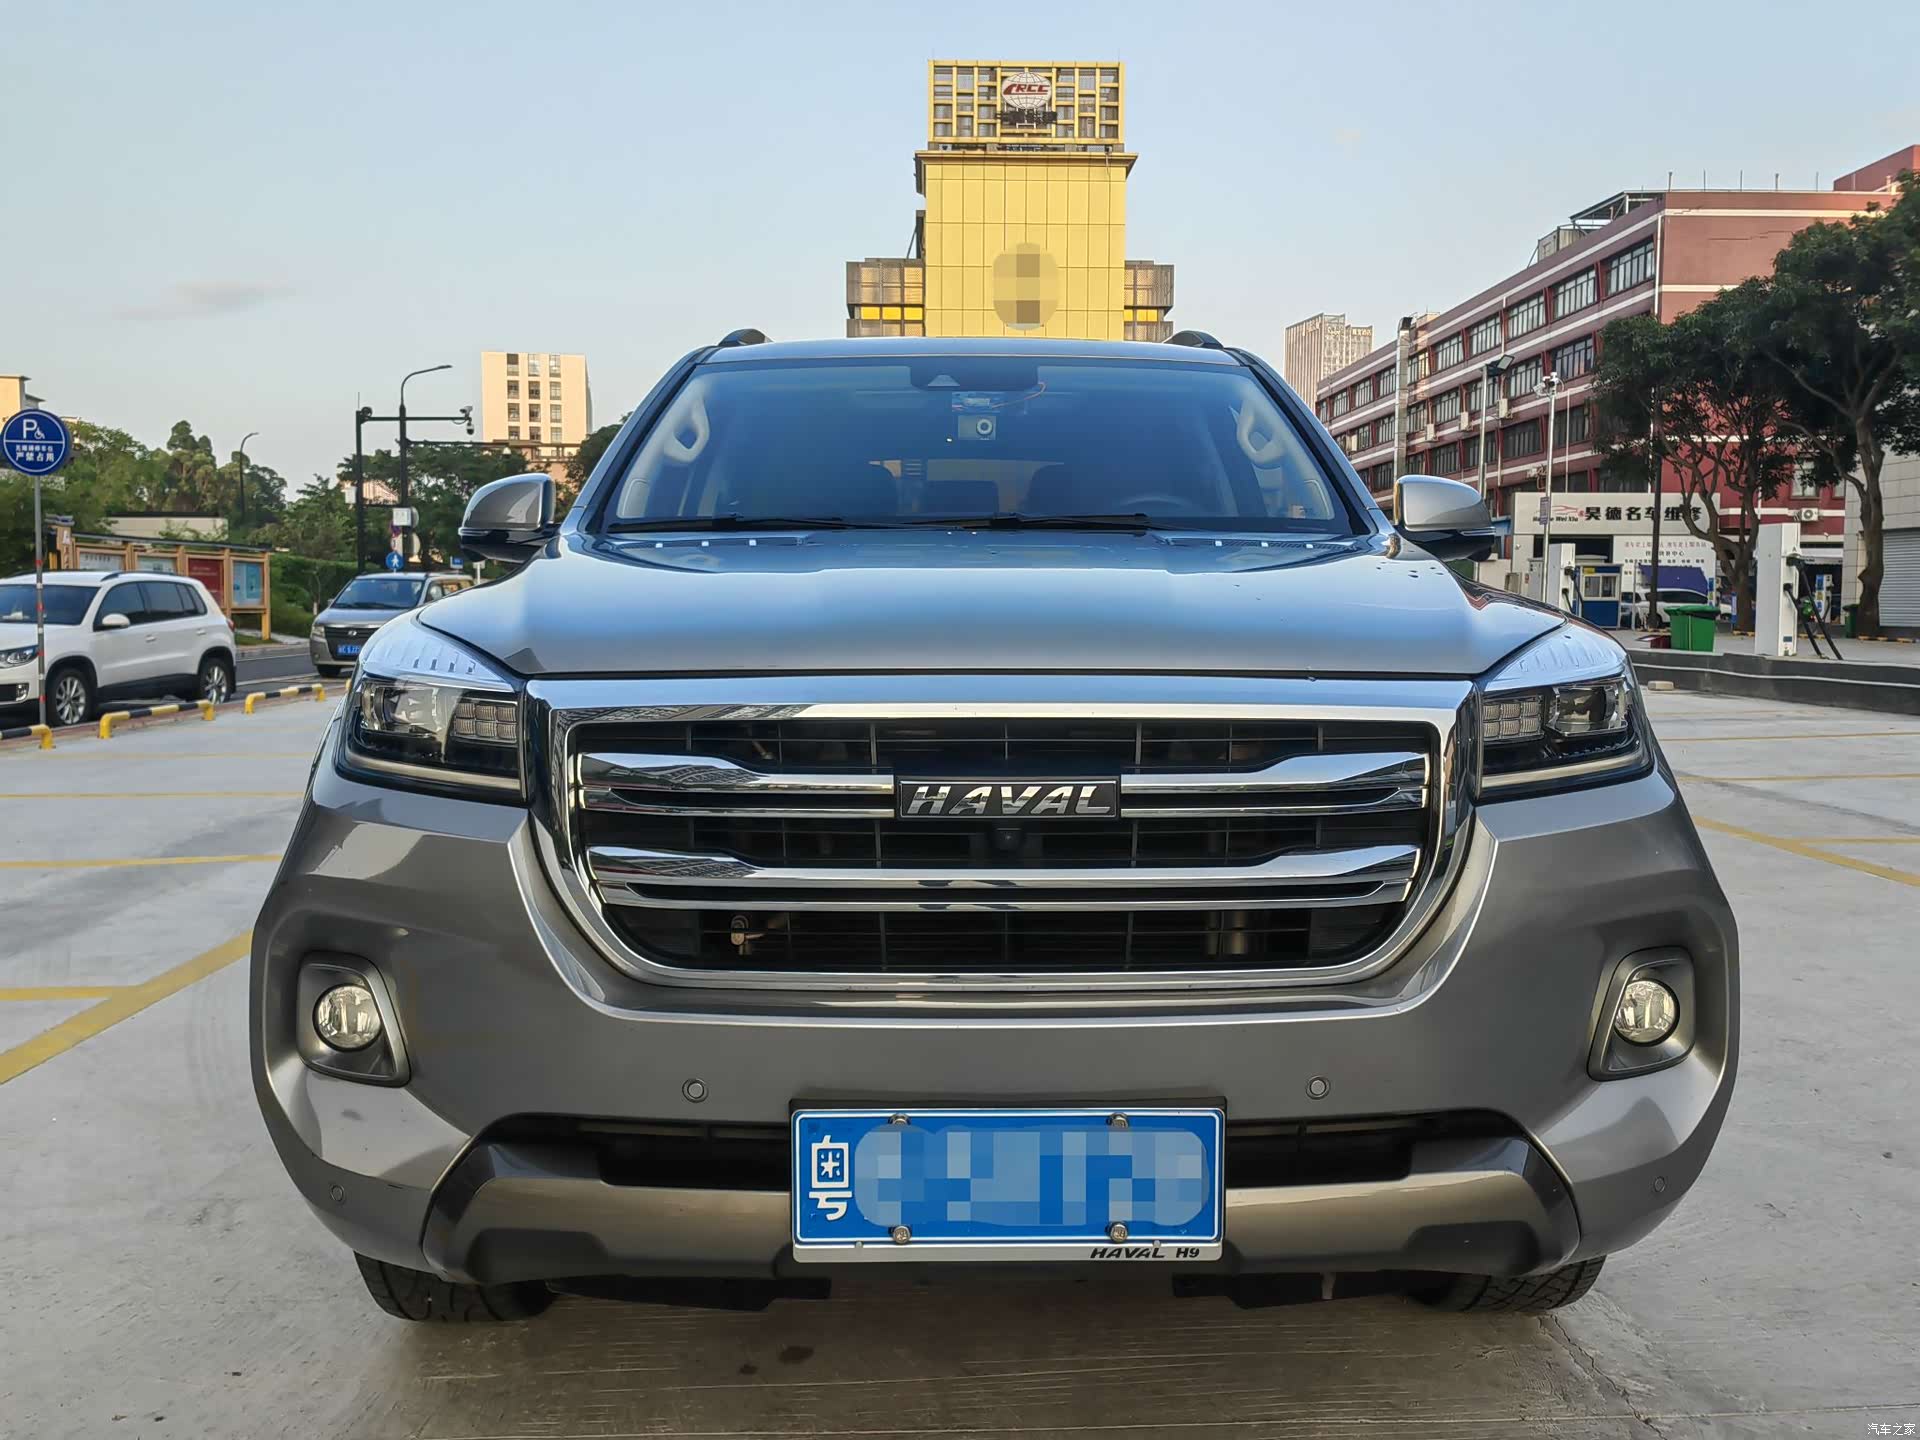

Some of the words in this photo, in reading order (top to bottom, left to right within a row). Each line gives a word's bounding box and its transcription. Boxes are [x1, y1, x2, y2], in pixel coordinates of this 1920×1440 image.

[22, 418, 38, 439] P
[906, 785, 1111, 815] HAVAL
[1090, 1247, 1165, 1259] HAVAL
[1175, 1247, 1200, 1259] H9
